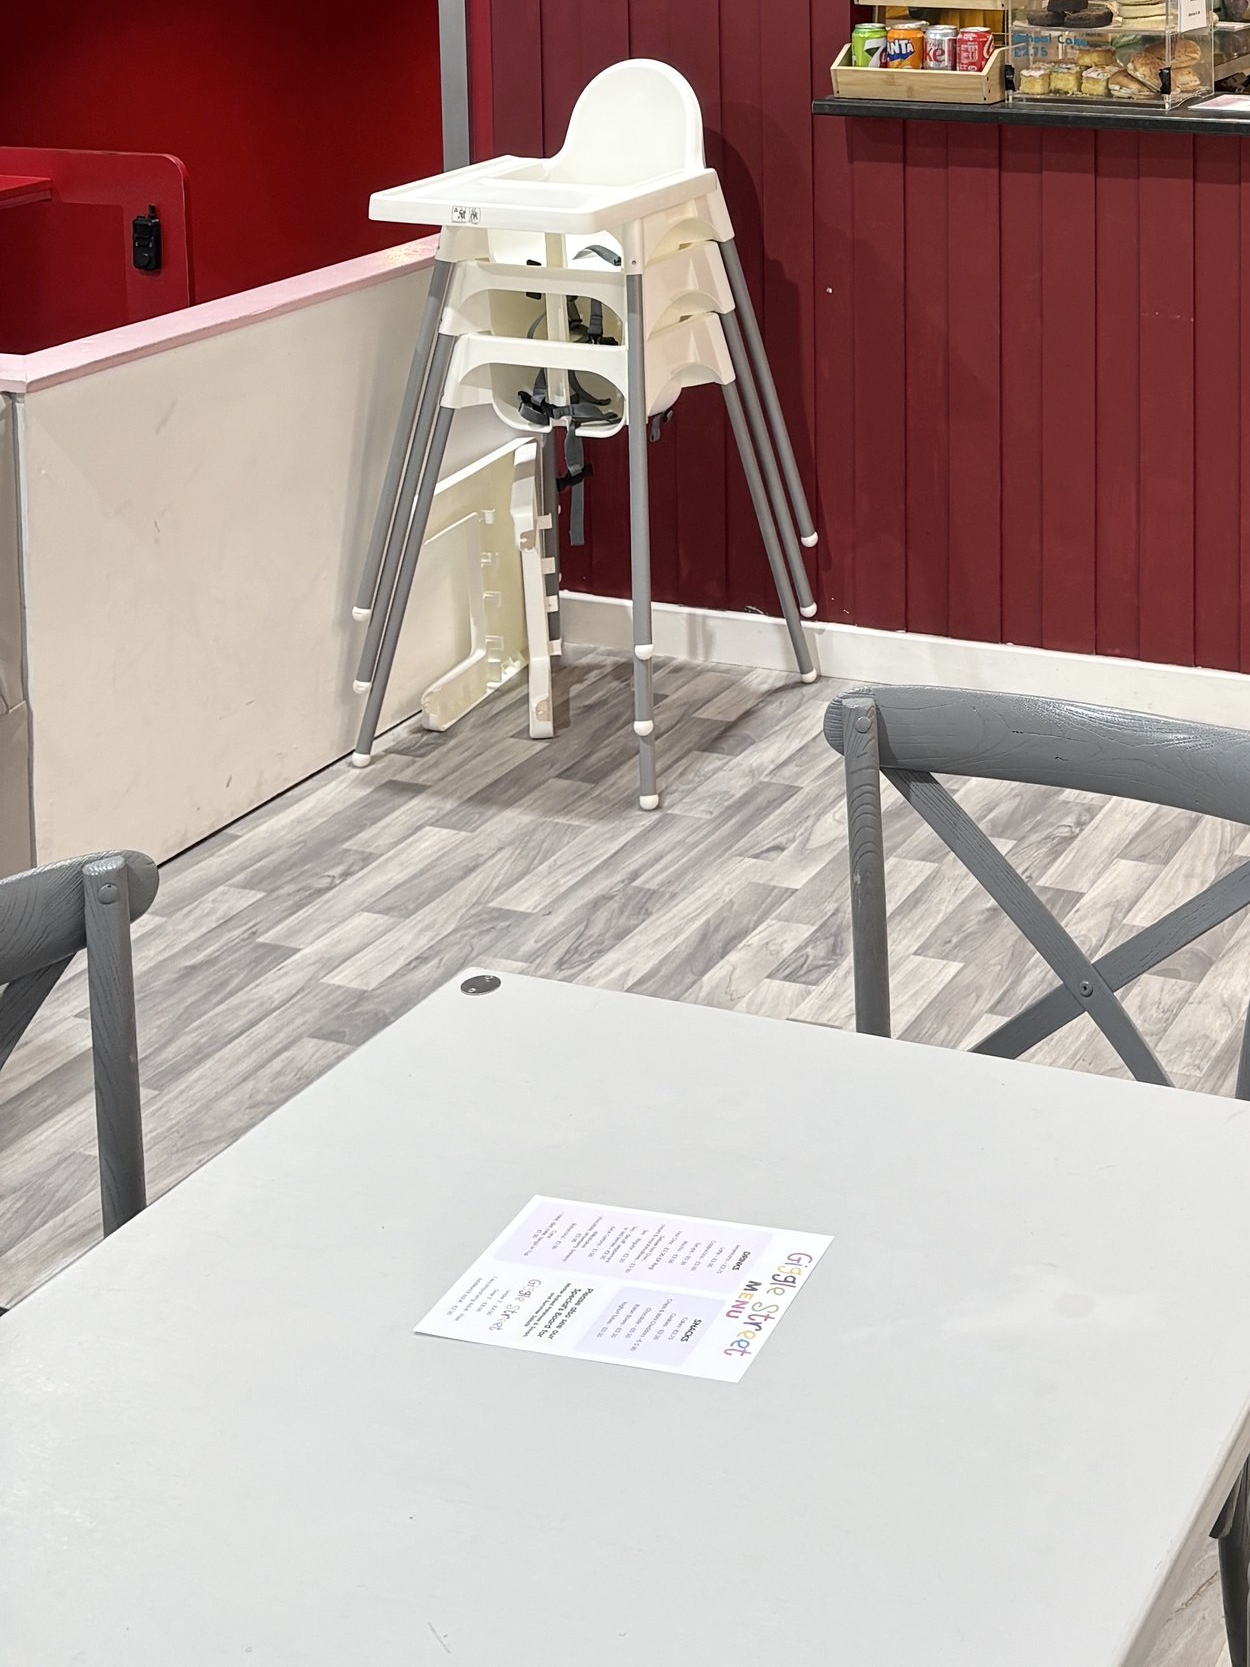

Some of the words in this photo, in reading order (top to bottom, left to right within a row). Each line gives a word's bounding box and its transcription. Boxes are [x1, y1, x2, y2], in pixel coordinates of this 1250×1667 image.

[732, 1251, 750, 1270] DRINKS
[766, 1252, 812, 1294] Giggle
[726, 1280, 761, 1318] MENU
[680, 1319, 701, 1341] SNACKS
[724, 1302, 777, 1355] Street
